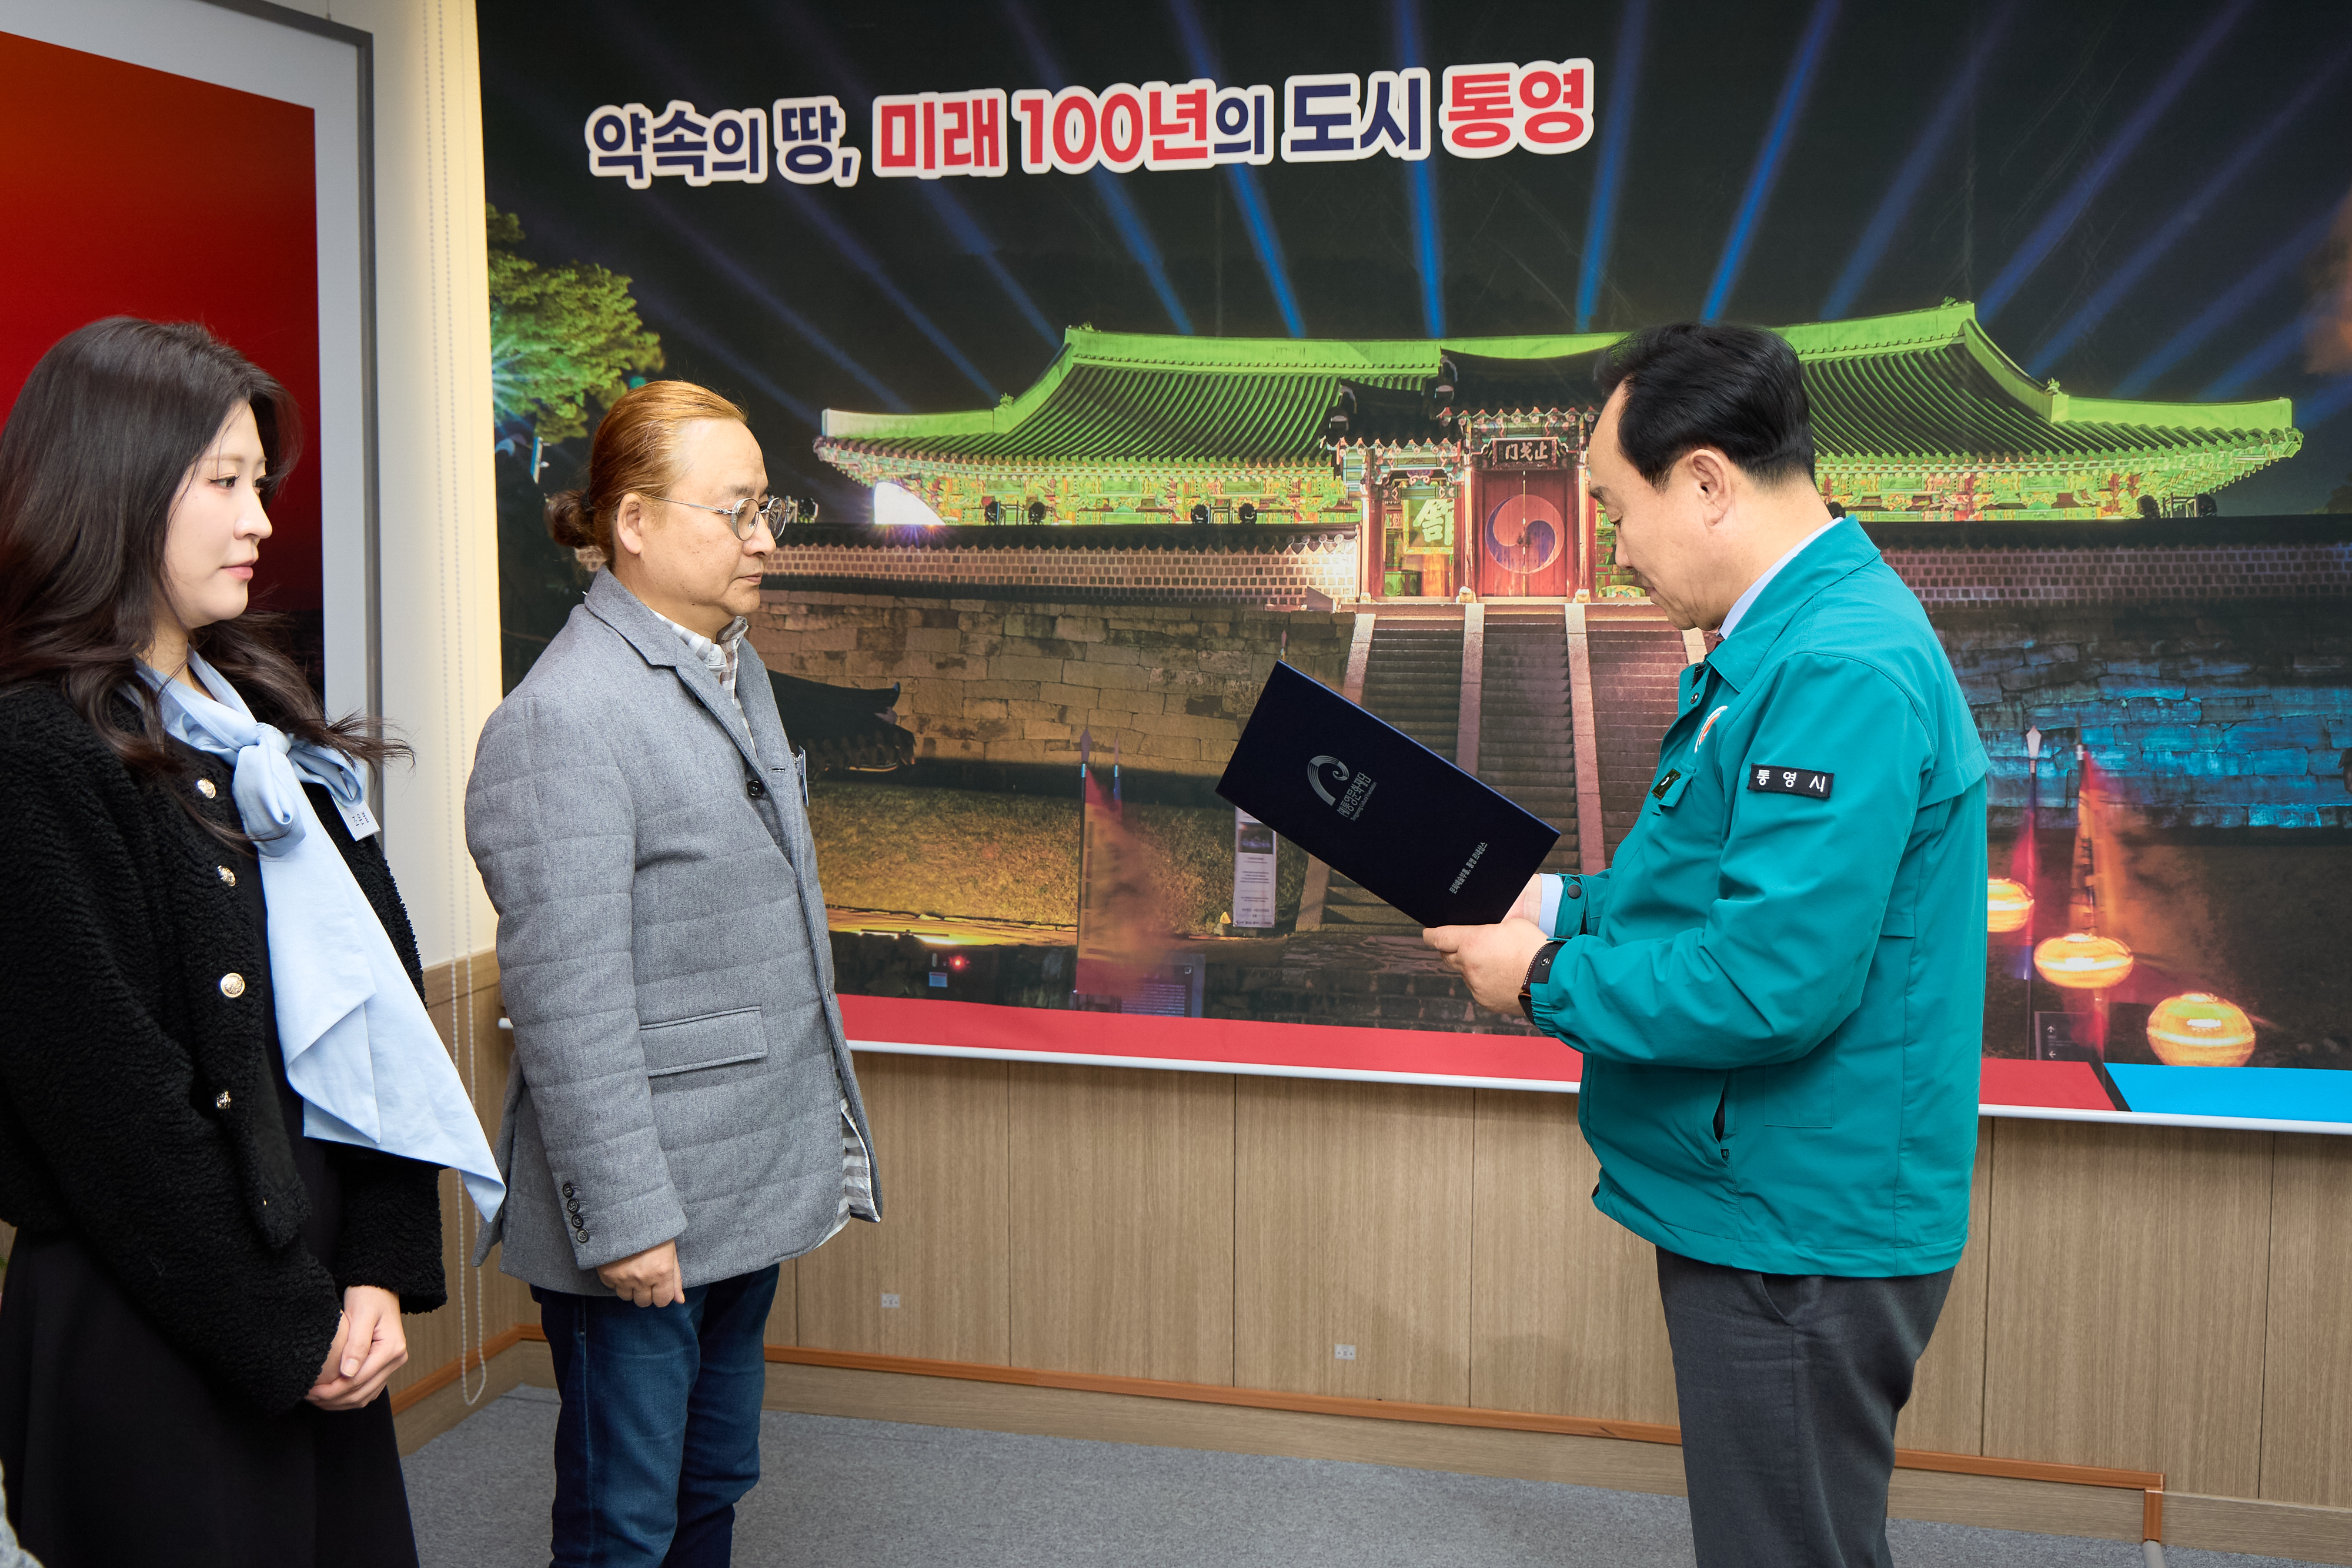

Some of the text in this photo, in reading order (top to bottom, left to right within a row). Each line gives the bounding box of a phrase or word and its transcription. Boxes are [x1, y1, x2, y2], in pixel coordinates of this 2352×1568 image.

[590, 65, 1587, 183] 약속의 땅, 미래 100년의 도시 통영
[1365, 781, 1377, 797] Foundation
[1465, 857, 1477, 869] 통영
